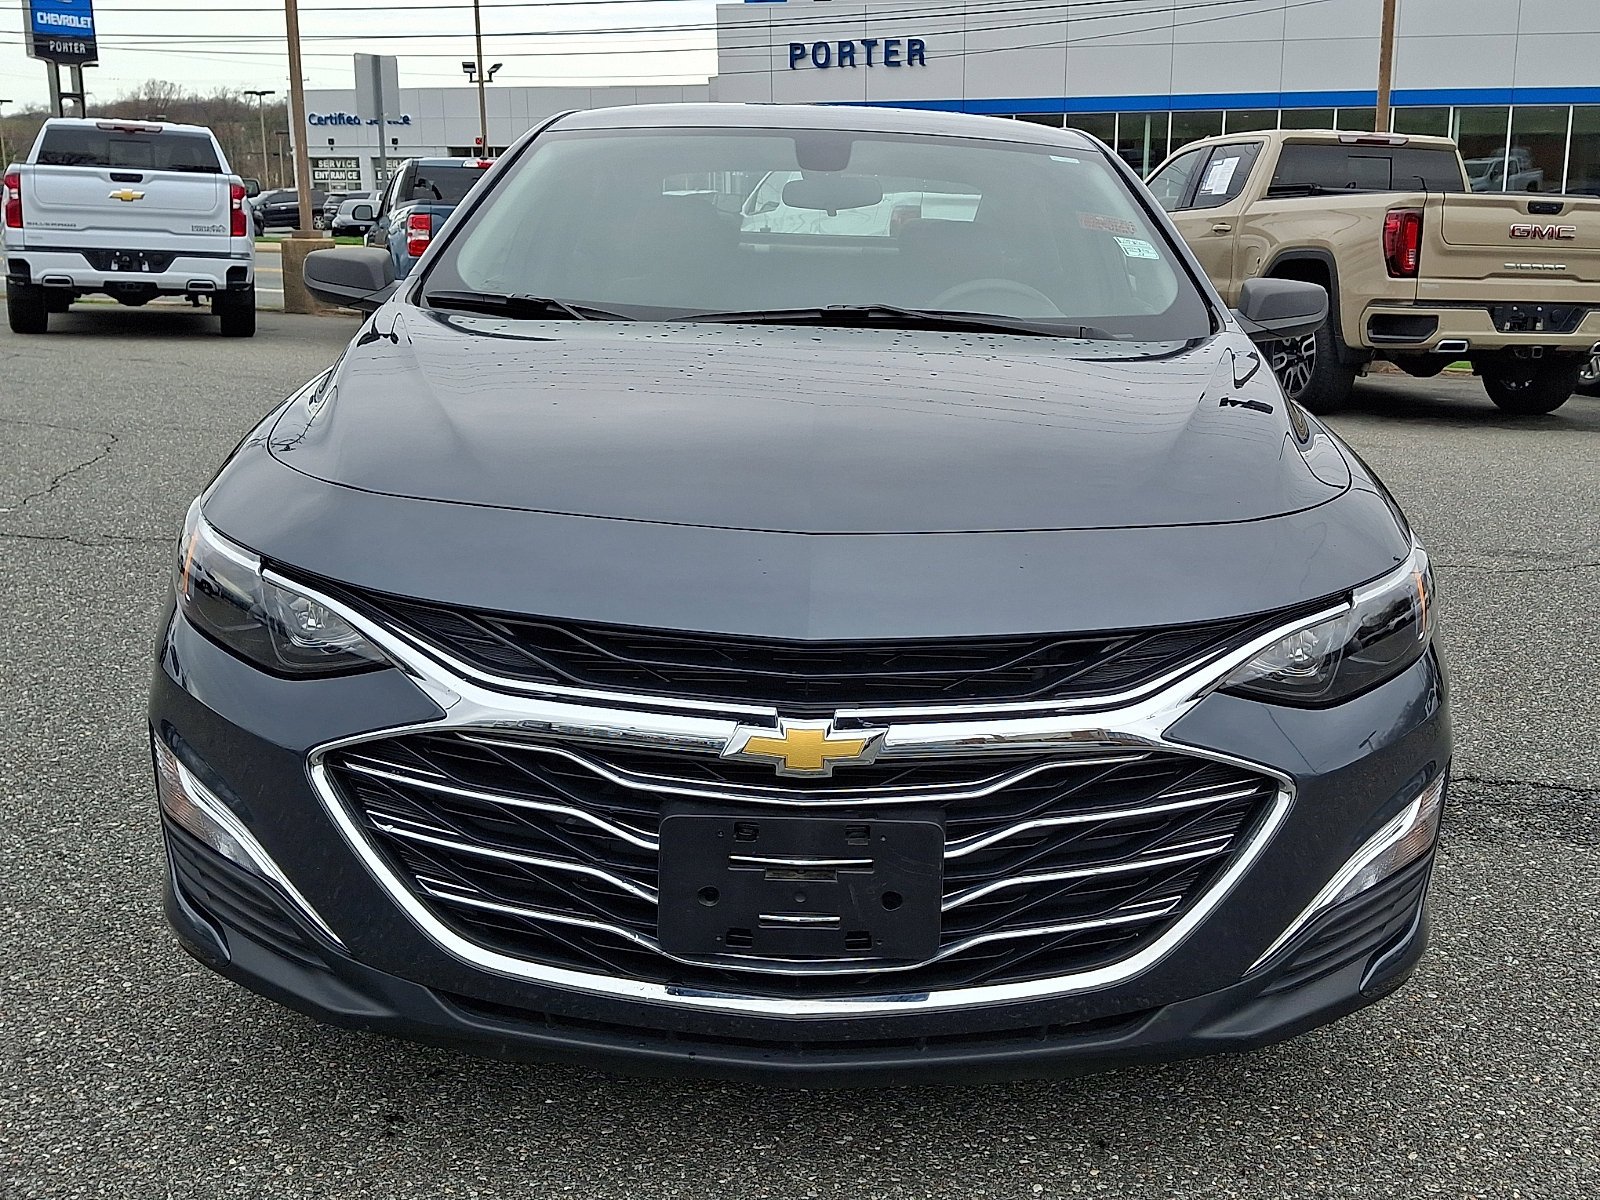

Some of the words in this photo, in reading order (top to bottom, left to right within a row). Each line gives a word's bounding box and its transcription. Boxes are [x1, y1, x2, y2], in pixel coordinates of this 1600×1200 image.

[37, 12, 92, 29] CHEVROLET
[49, 40, 86, 54] PORTER
[789, 38, 926, 70] PORTER
[318, 160, 357, 168] SERVICE
[314, 171, 358, 179] ENTRANCE
[1509, 224, 1576, 240] GMC
